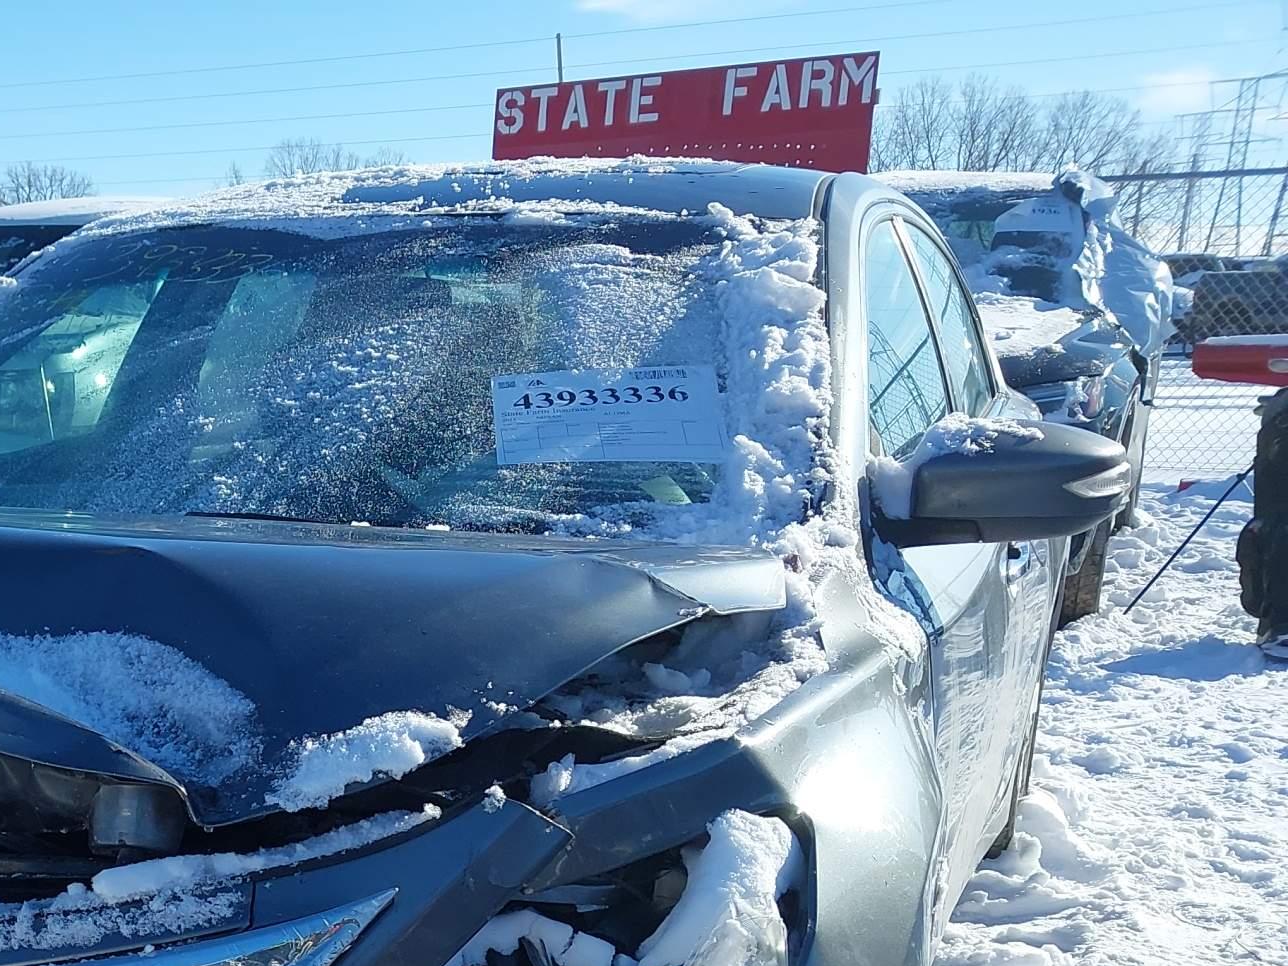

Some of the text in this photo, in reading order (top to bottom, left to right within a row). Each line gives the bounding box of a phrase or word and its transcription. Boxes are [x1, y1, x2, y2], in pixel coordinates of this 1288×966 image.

[497, 56, 876, 135] STATE FARM
[513, 385, 689, 410] 43933336
